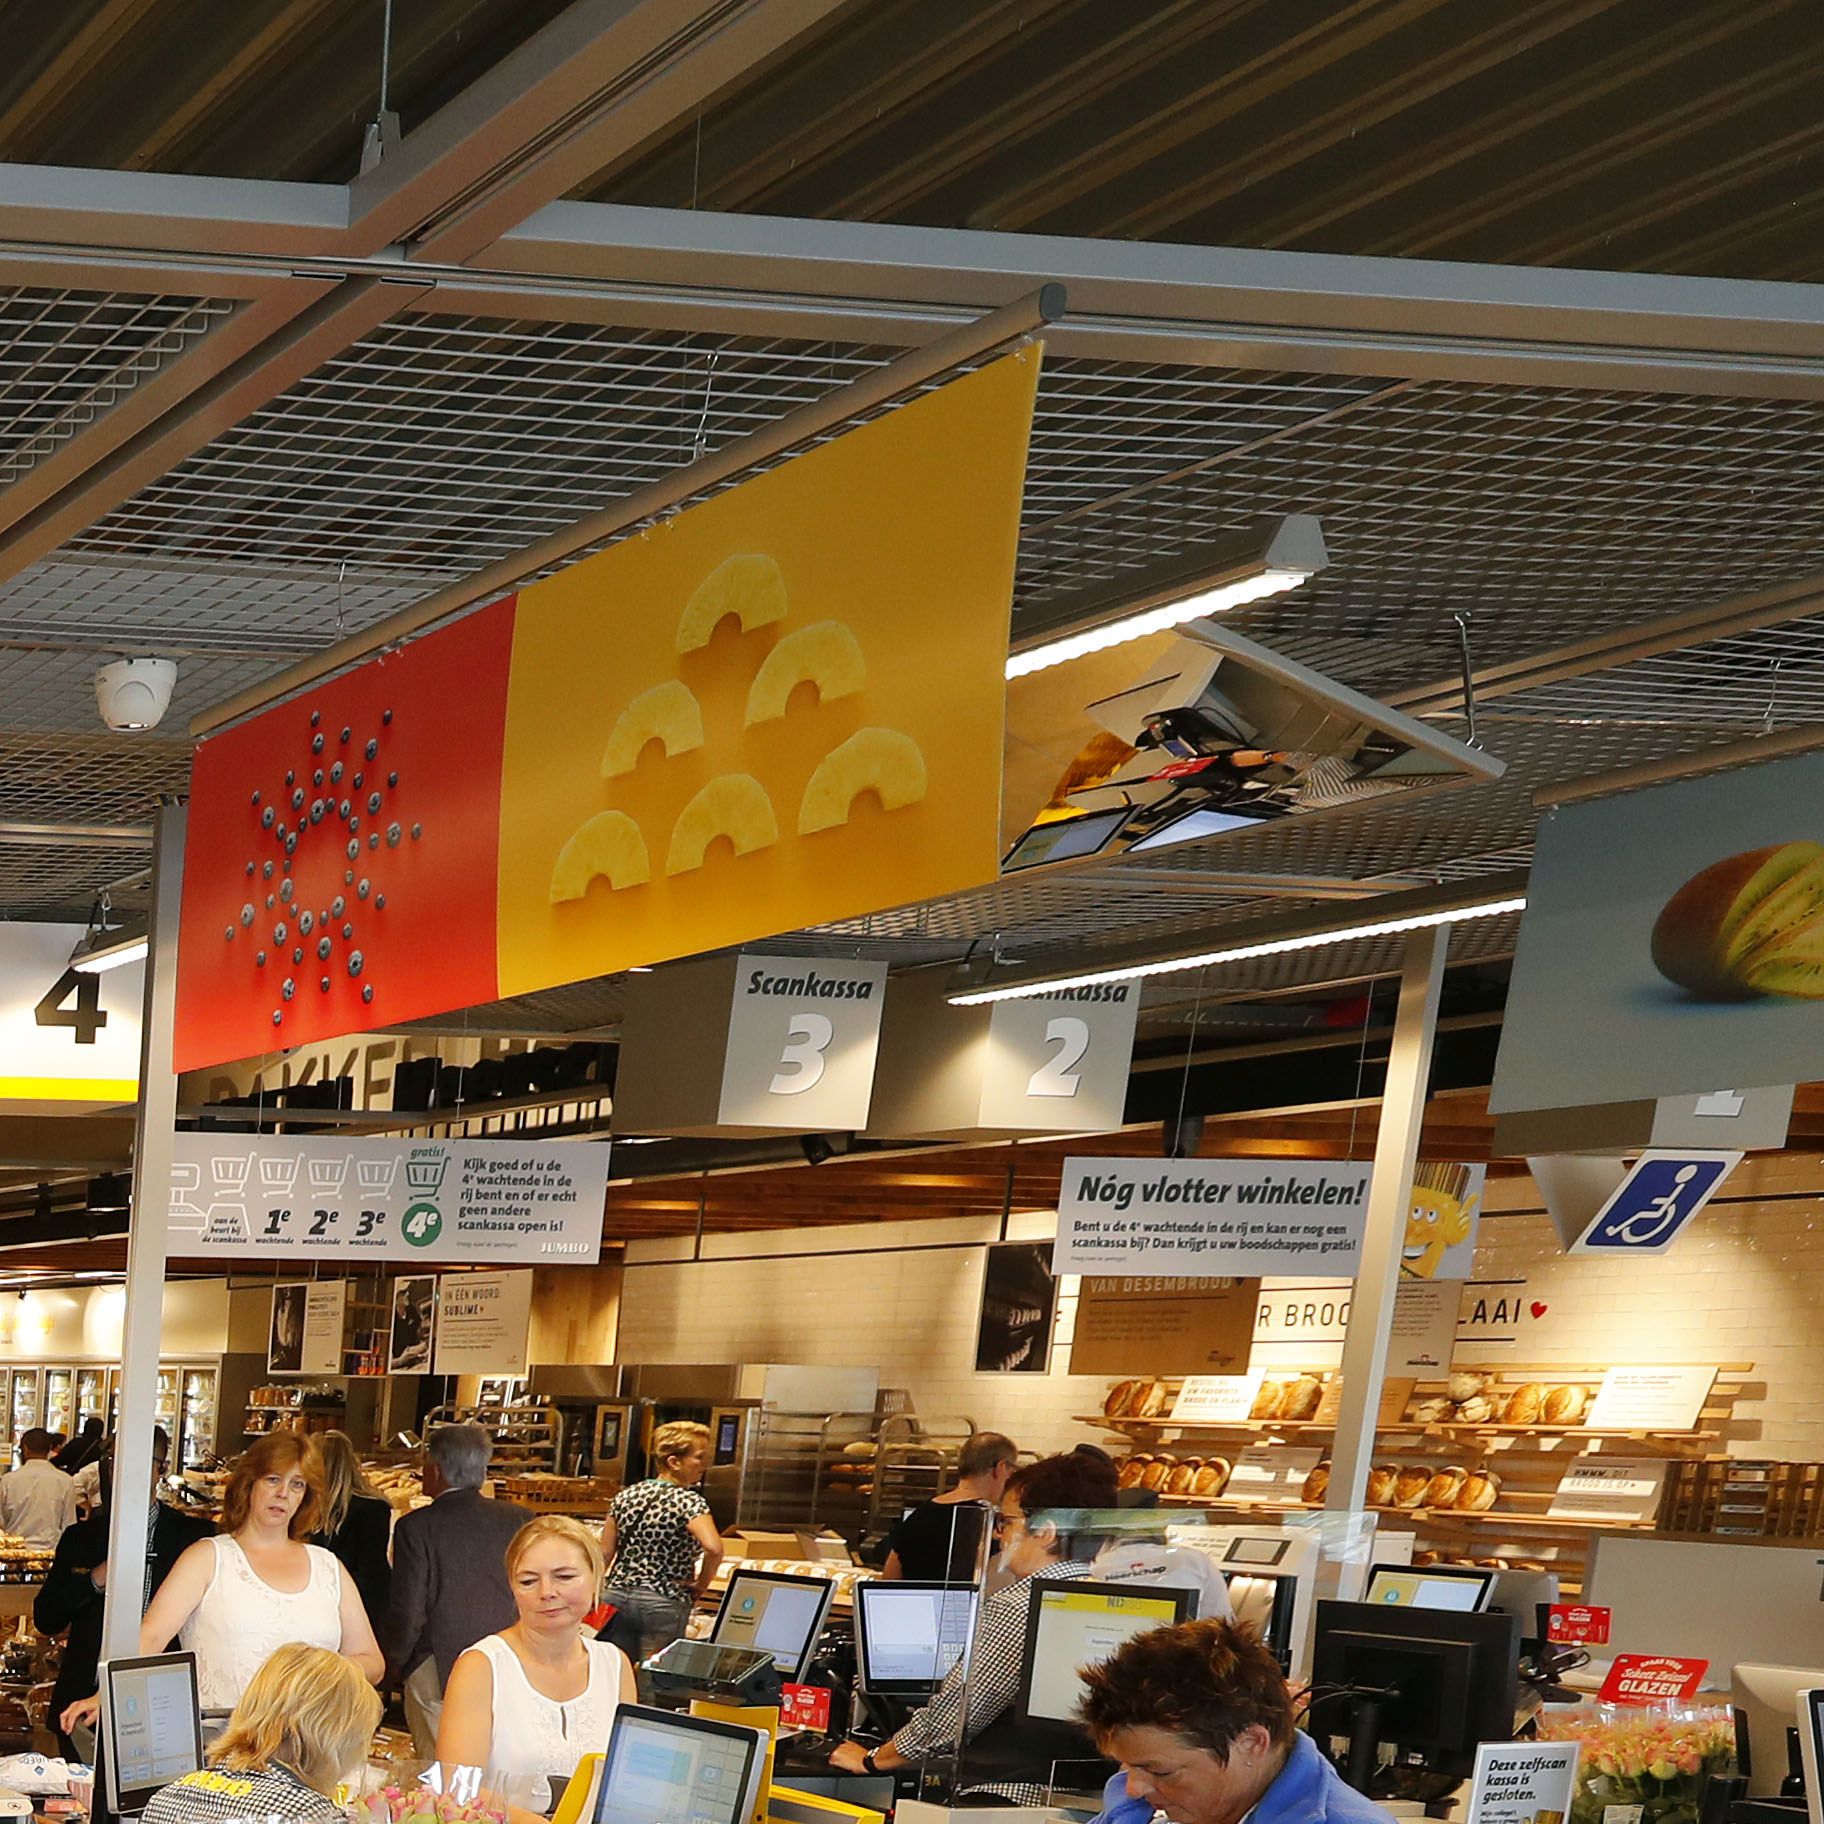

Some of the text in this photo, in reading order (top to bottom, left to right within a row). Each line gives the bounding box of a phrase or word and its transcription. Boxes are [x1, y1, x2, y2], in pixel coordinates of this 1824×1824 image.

[748, 970, 874, 1000] Scankassa
[34, 967, 108, 1045] 4
[769, 1013, 833, 1095] 3
[1026, 1017, 1089, 1096] 2
[1077, 1174, 1368, 1210] Nóg vlotter winkelen!
[264, 1209, 291, 1234] 1e
[309, 1210, 339, 1235] 2e
[356, 1211, 386, 1236] 3e
[406, 1211, 438, 1238] 4e
[1073, 1221, 1100, 1232] Bent
[1103, 1223, 1110, 1232] u
[1113, 1221, 1127, 1233] de
[1143, 1221, 1204, 1234] wachtende
[1207, 1222, 1218, 1234] in
[1220, 1222, 1234, 1234] de
[1236, 1222, 1249, 1237] rij
[1250, 1225, 1263, 1234] en
[1266, 1223, 1287, 1234] kan
[1289, 1225, 1301, 1234] er
[1303, 1225, 1325, 1238] nog
[1327, 1225, 1347, 1235] een
[540, 1242, 589, 1254] JUMBO
[1072, 1237, 1356, 1254] scankassa bij? Dan krijgt u uw boodschappen gratis!
[1090, 1278, 1117, 1293] VAN
[444, 1305, 479, 1315] SUBLIME
[1618, 1680, 1682, 1696] GLAZEN
[1488, 1757, 1567, 1774] Deze zelfscan
[1486, 1773, 1530, 1786] kassa is
[1482, 1788, 1536, 1805] gesloten.
